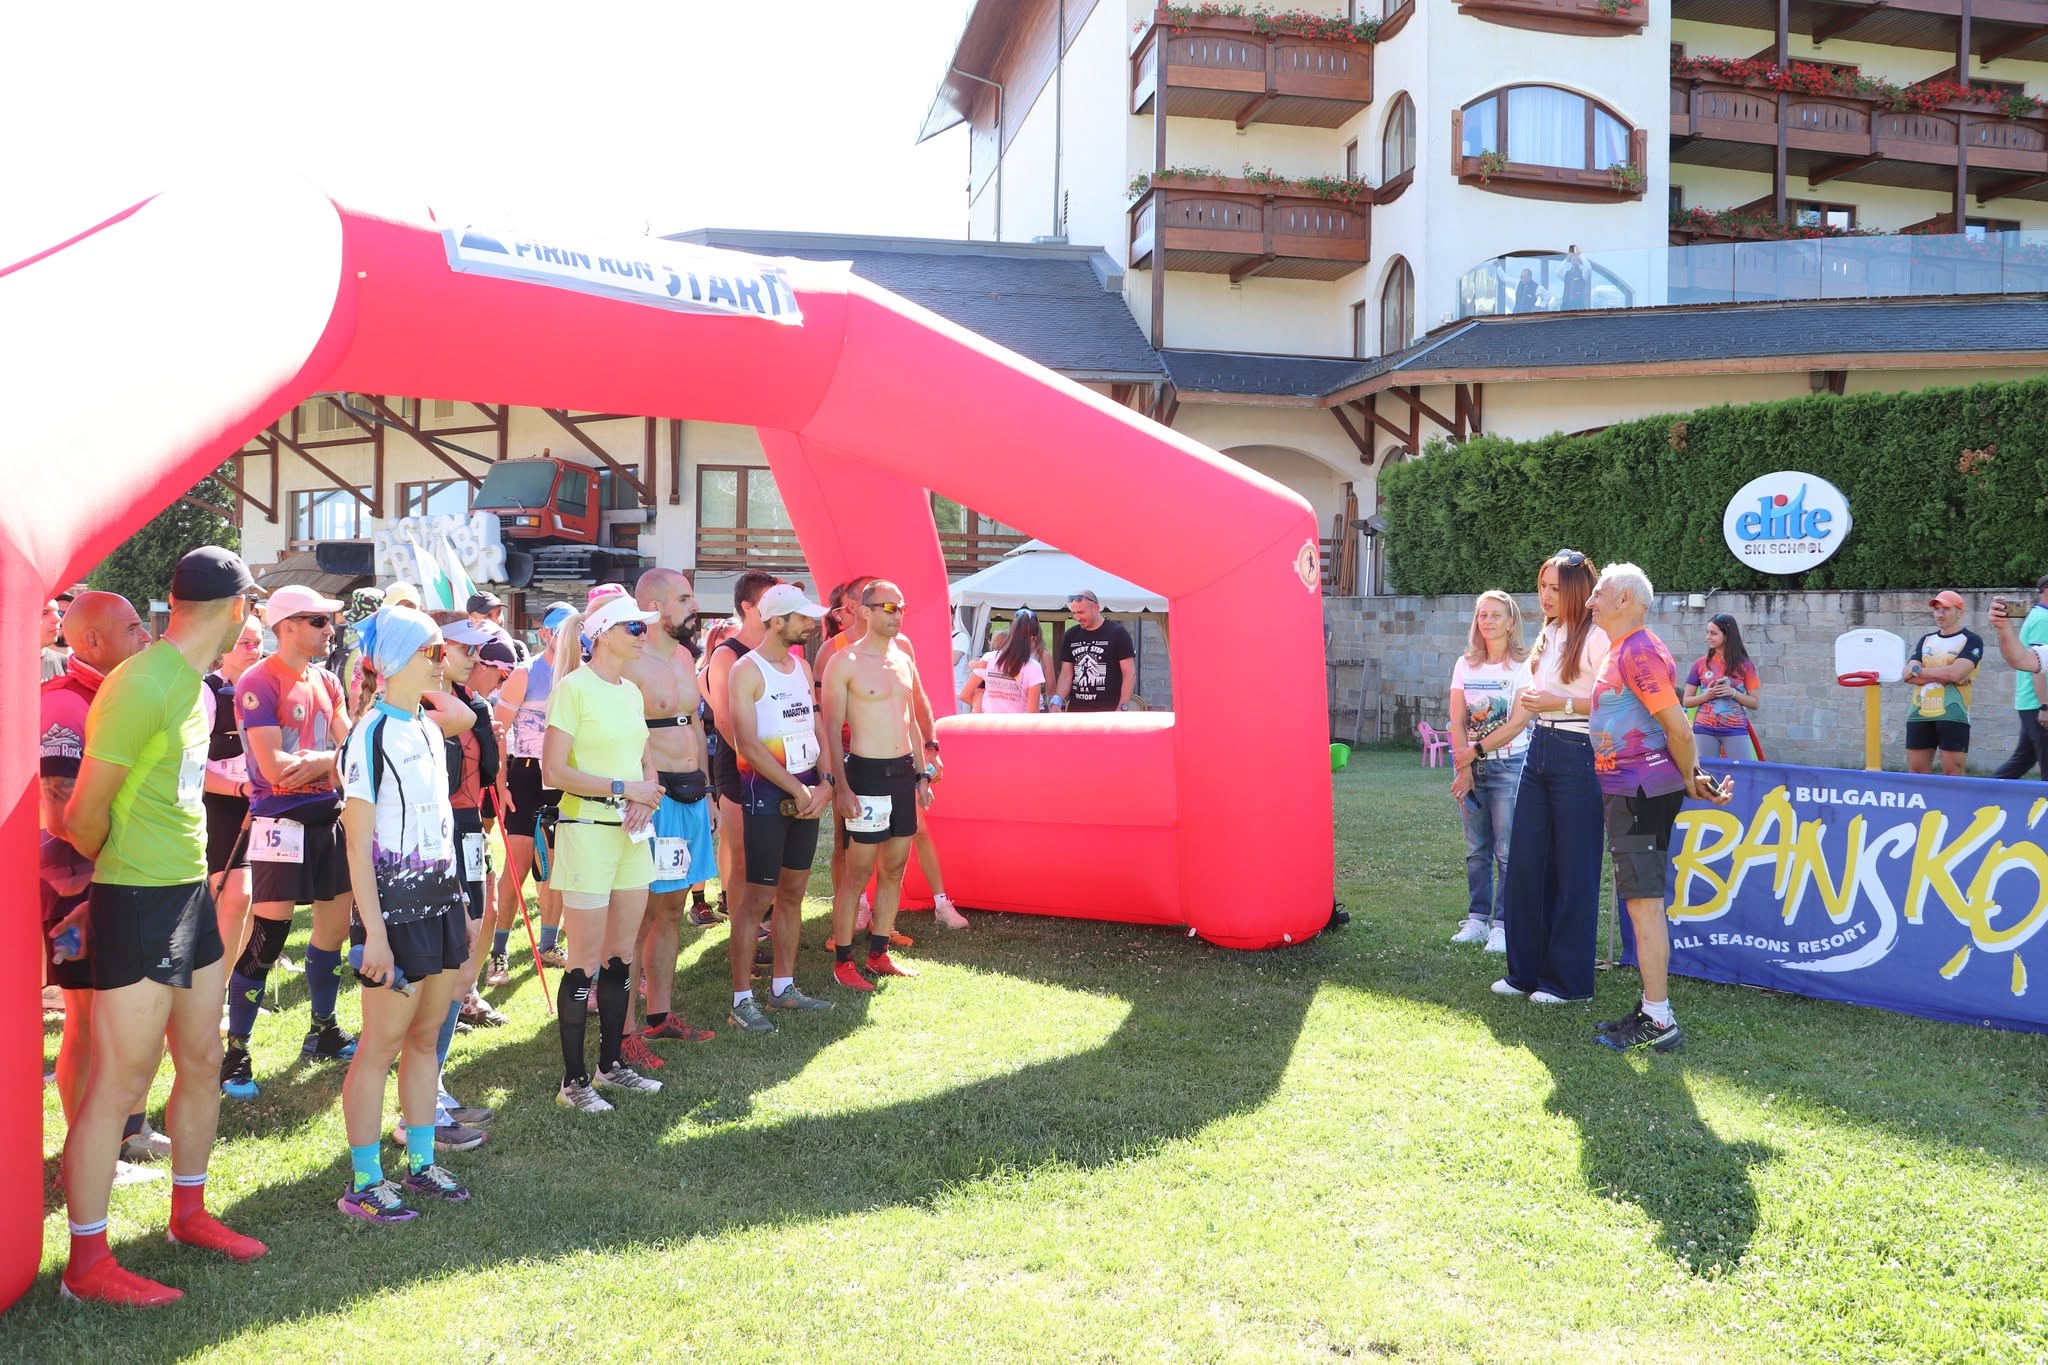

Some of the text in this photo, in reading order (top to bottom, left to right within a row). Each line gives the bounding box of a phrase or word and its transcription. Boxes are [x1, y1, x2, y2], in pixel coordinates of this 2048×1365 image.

[515, 241, 591, 270] PIRIN
[598, 256, 654, 281] RUN
[1735, 483, 1832, 541] elite
[1744, 542, 1824, 555] SKI SCHOOL
[1072, 645, 1105, 656] EVERY STEP
[783, 706, 810, 718] MARATHON
[802, 743, 806, 759] 1
[1796, 787, 1927, 809] BULGARIA
[863, 806, 873, 820] 2
[265, 829, 281, 847] 15
[672, 849, 684, 867] 37
[1666, 785, 2048, 972] BANSKO
[1674, 921, 1867, 954] ALL SEASONS RESORT
